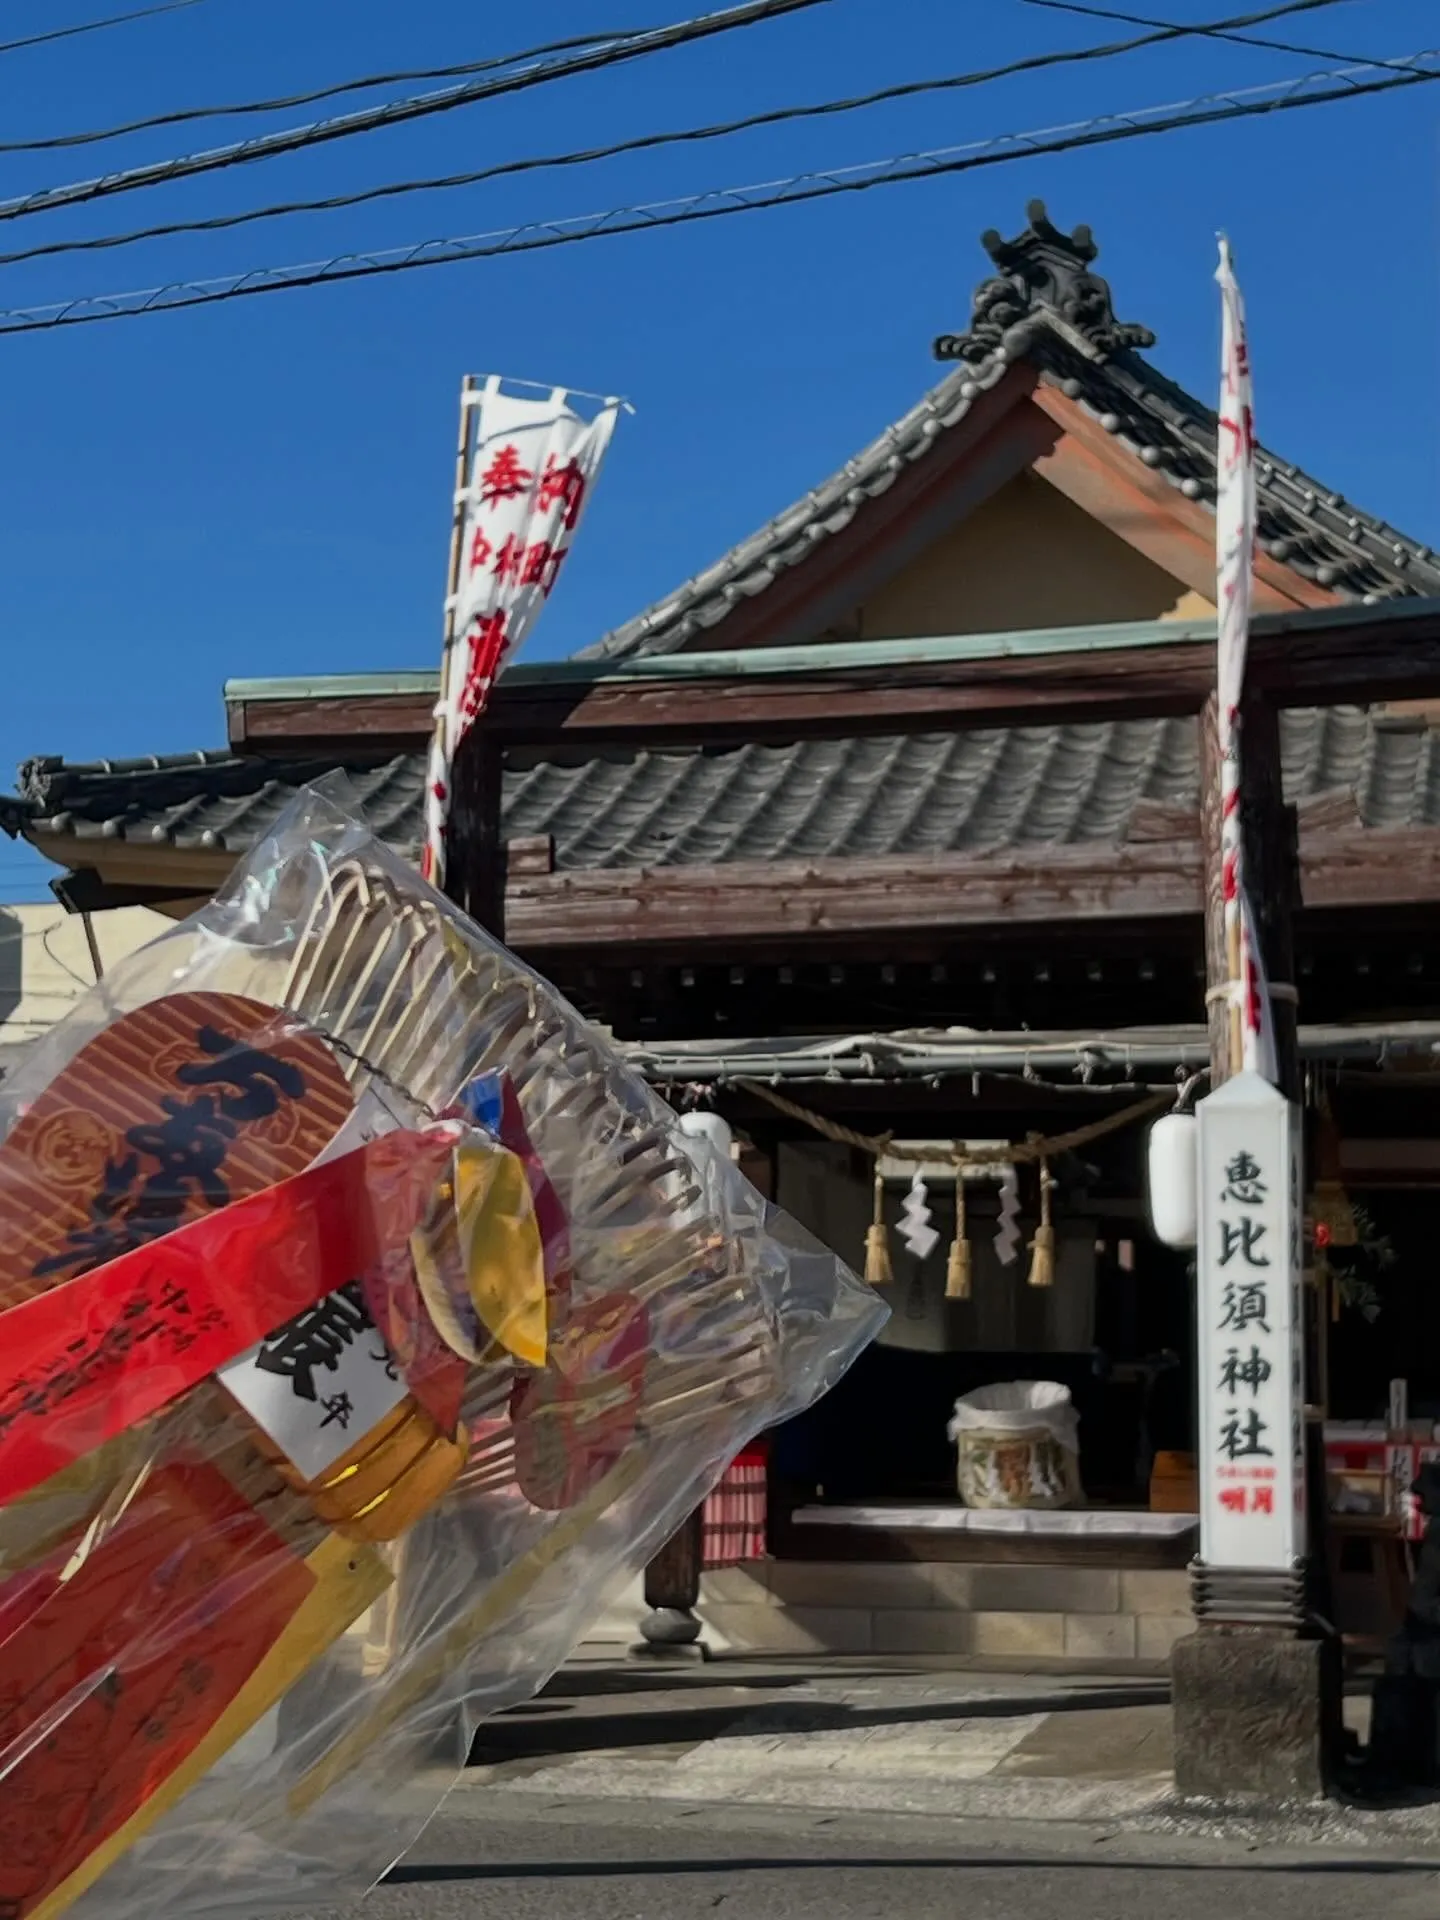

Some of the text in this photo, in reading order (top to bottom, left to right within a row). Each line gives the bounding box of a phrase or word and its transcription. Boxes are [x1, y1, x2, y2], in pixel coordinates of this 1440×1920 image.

[479, 444, 585, 531] 奉納
[1216, 1149, 1273, 1461] 恵比須神社
